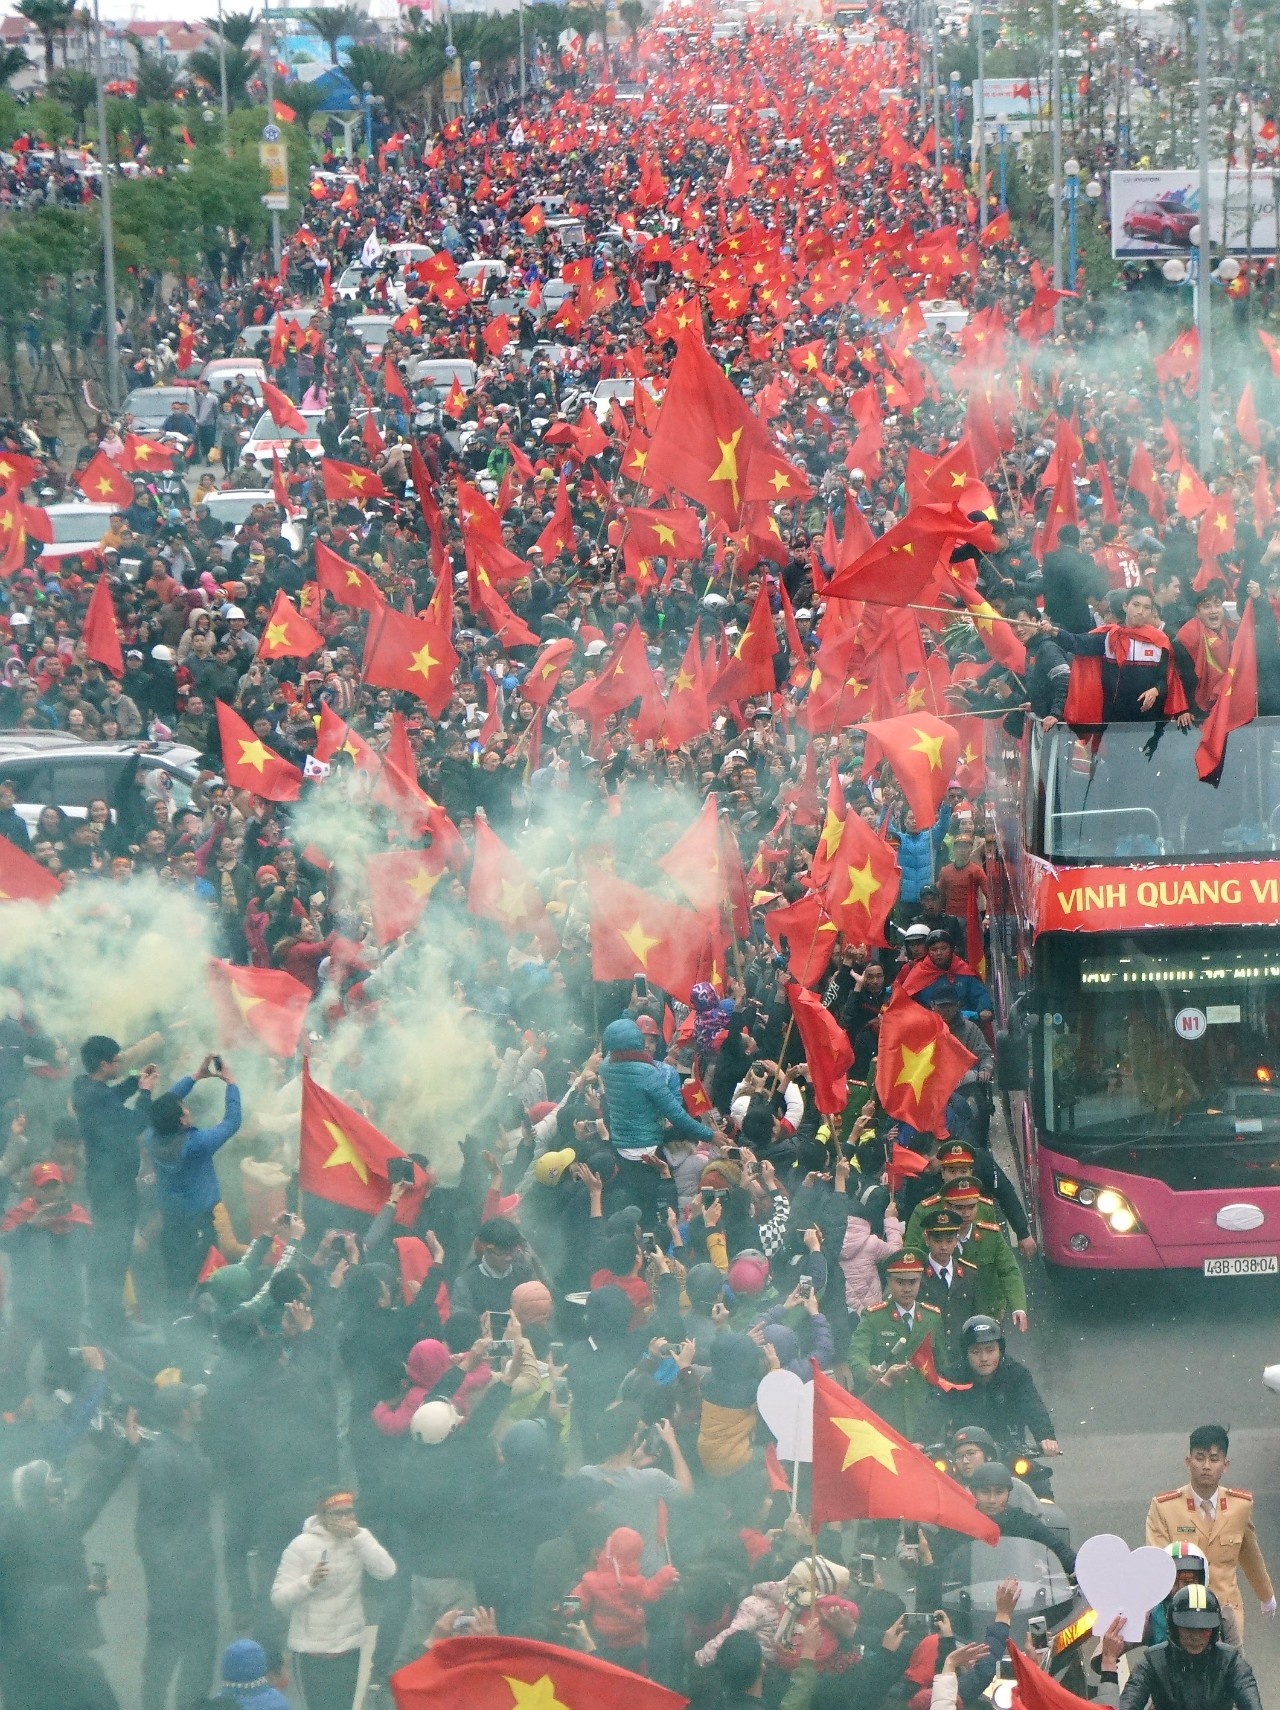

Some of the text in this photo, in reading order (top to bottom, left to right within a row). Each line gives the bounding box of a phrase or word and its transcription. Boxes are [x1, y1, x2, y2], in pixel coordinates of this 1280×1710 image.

[1118, 559, 1141, 589] 19
[1057, 883, 1127, 914] VINH
[1137, 879, 1242, 909] QUANG
[1182, 1016, 1199, 1031] N1
[1207, 1258, 1276, 1275] 43B-038.04
